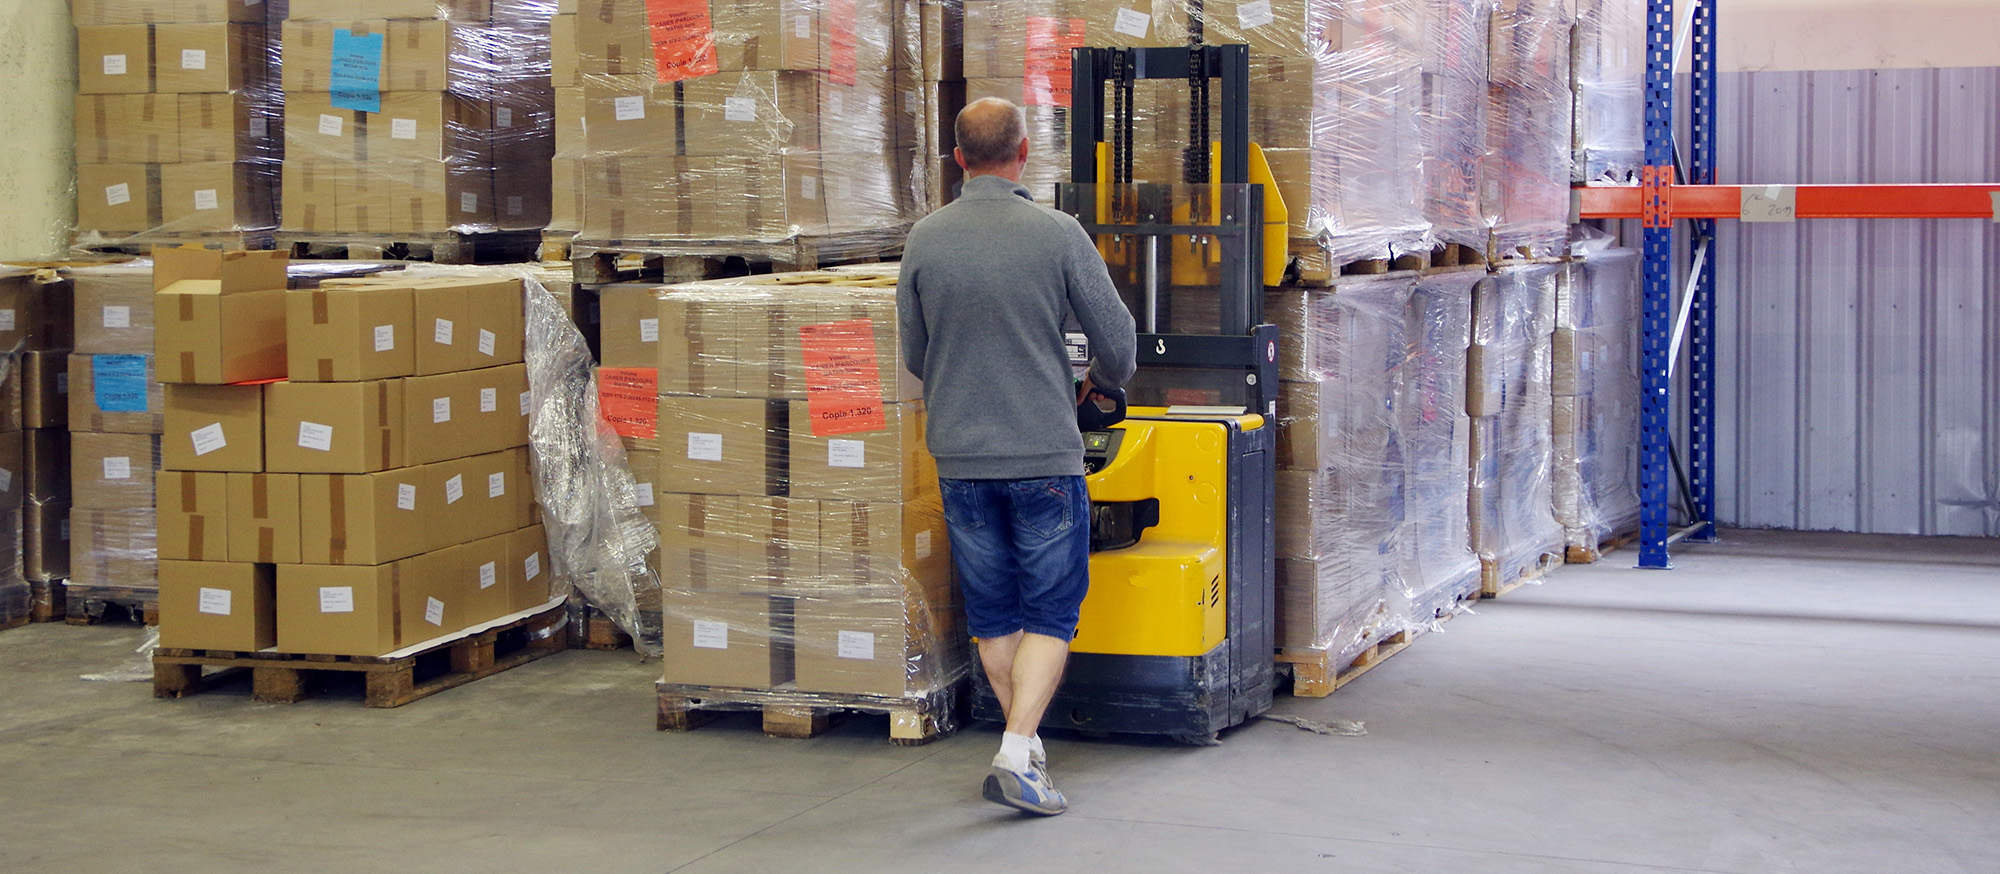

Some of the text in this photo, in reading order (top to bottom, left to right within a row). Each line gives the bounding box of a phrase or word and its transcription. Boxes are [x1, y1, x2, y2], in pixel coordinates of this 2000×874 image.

[655, 19, 674, 27] CAHIER
[666, 60, 687, 69] Copie
[822, 406, 872, 421] Copie 1.320
[607, 414, 627, 424] Copie
